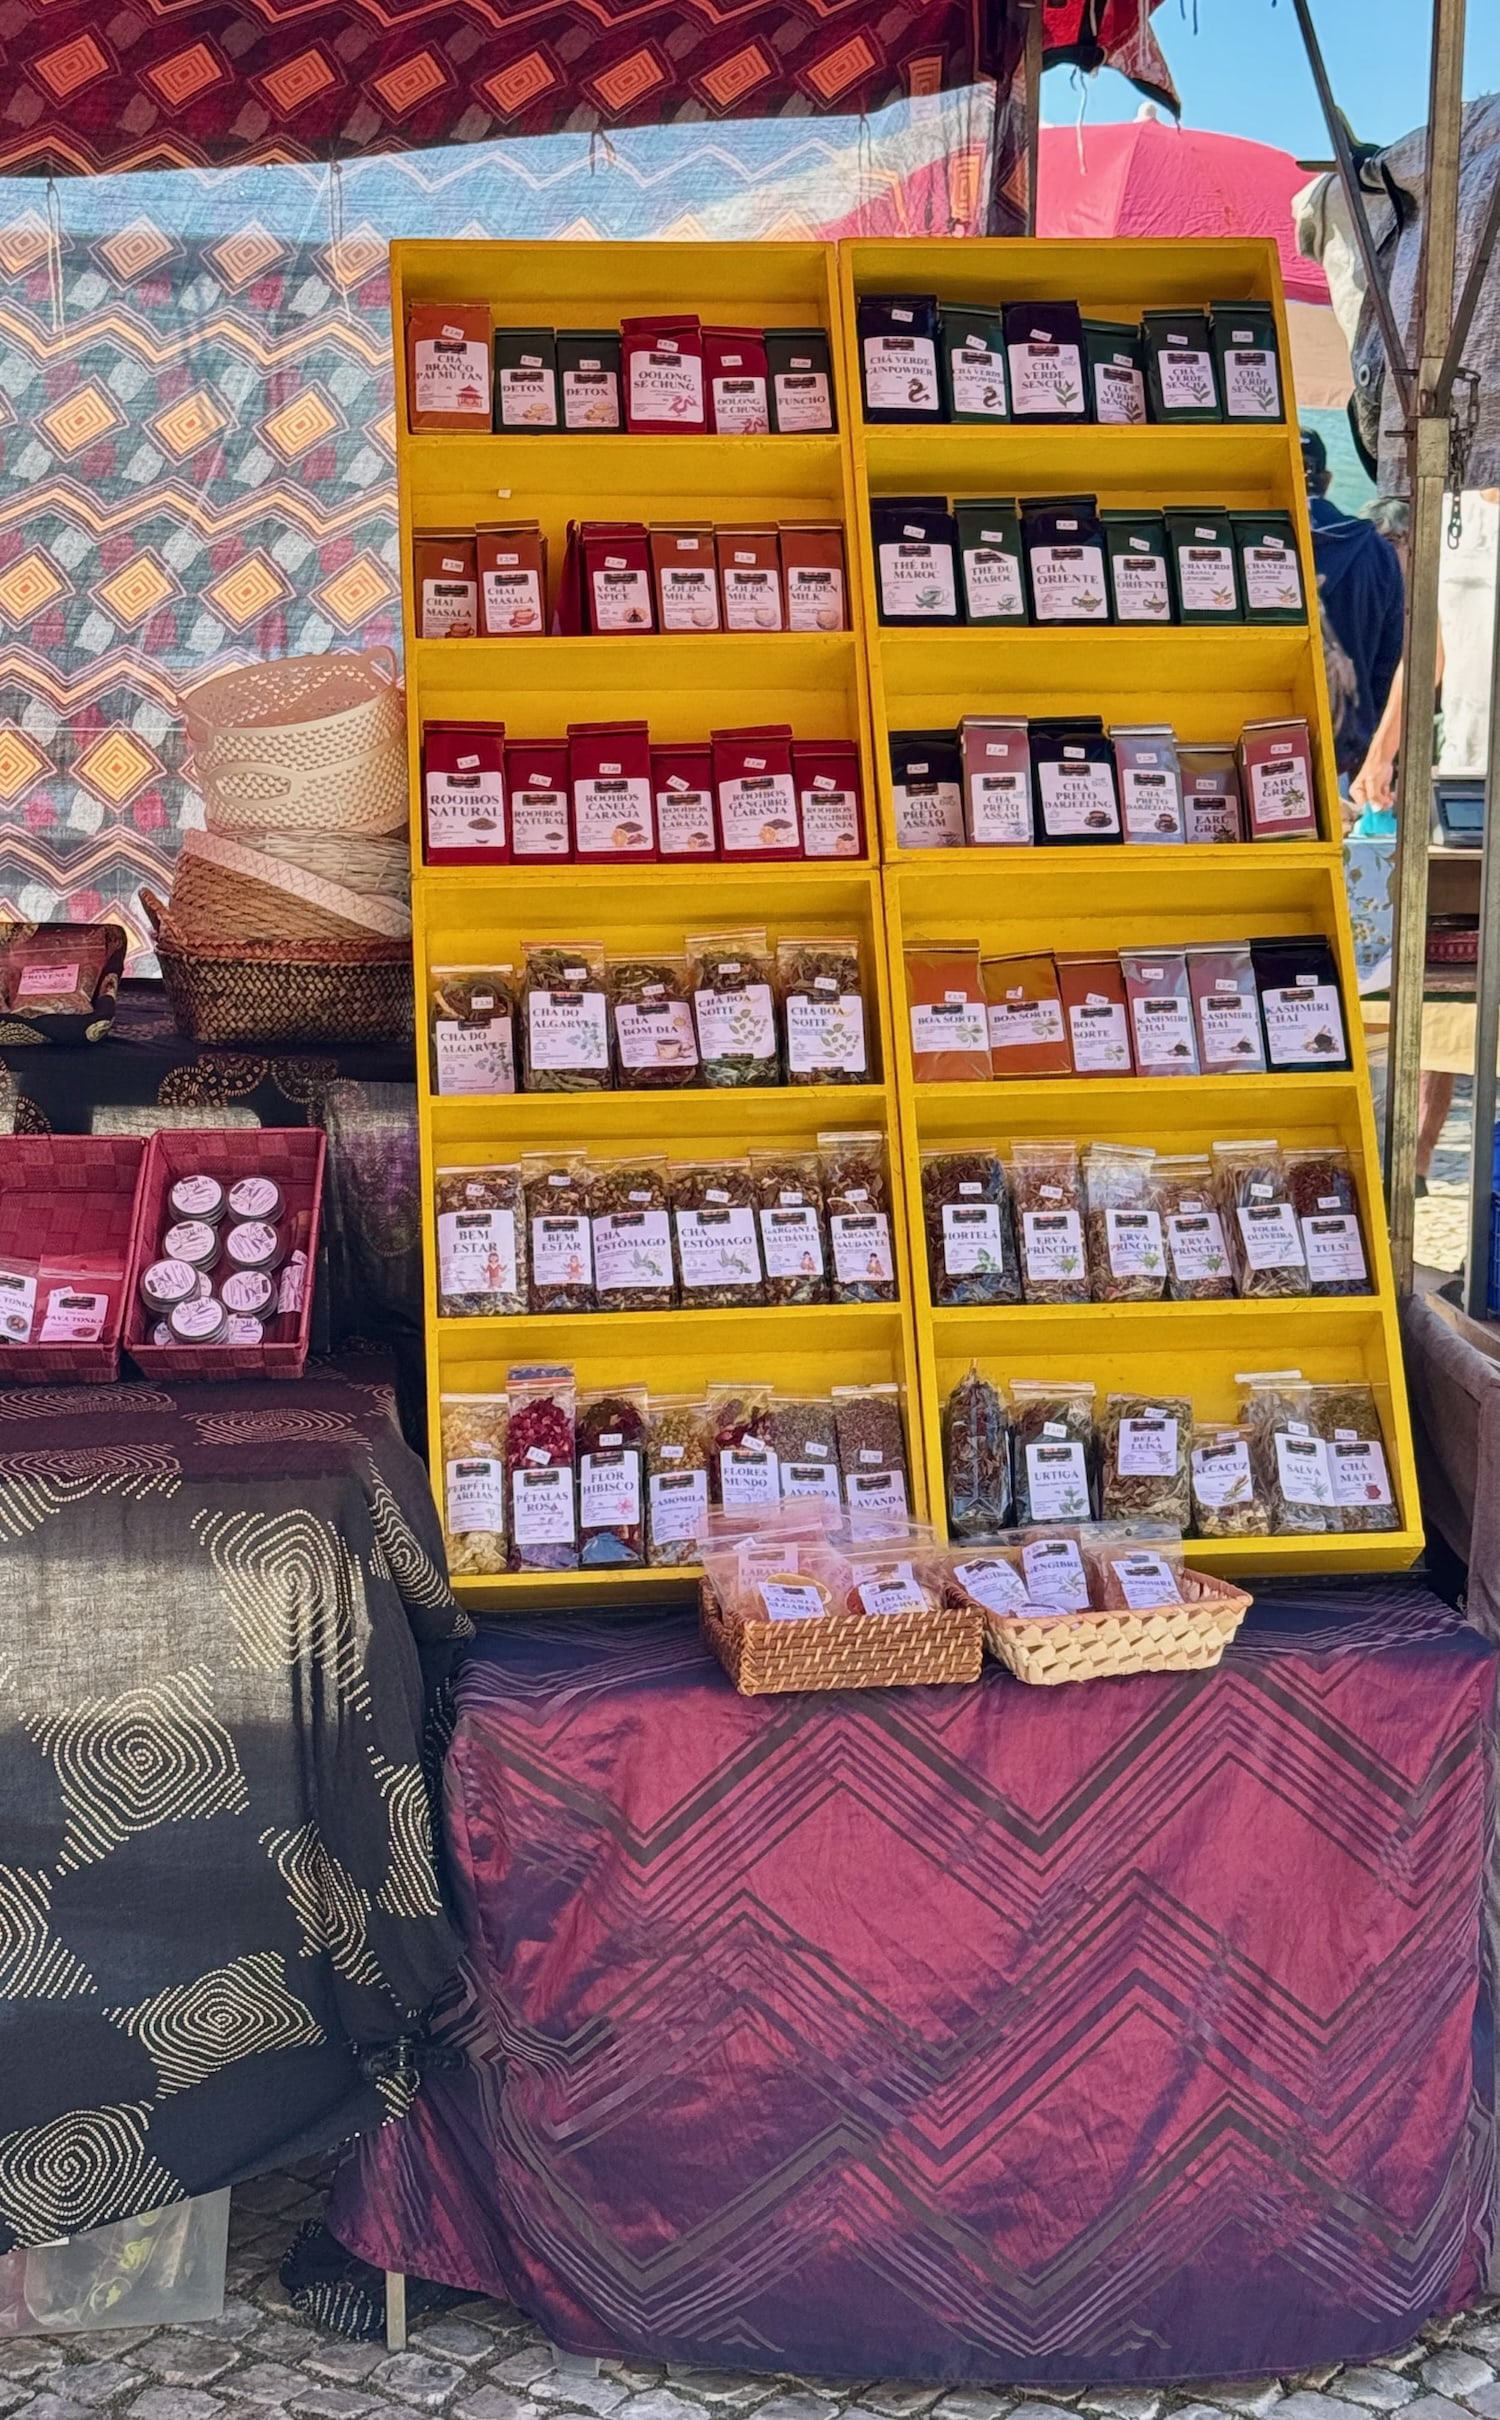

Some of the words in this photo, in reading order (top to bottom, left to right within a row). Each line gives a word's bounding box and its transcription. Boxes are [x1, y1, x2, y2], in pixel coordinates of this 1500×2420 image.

[898, 357, 930, 365] VERDE
[867, 367, 933, 376] GUNPOWDER
[639, 371, 692, 382] OOLONG
[634, 380, 649, 388] SE
[651, 380, 694, 391] CHUNG
[567, 388, 608, 396] DETOX
[778, 396, 825, 405] FUNCHO
[921, 562, 938, 570] DU
[999, 566, 1014, 574] DU
[894, 570, 939, 579] MAROC
[972, 574, 1014, 584] MAROC
[1037, 574, 1098, 585] ORIENTE
[597, 585, 627, 593] YOGI
[663, 584, 711, 593] GOLDEN
[726, 584, 774, 593] GOLDEN
[789, 584, 838, 593] GOLDEN
[1117, 581, 1168, 589] ORIENTE
[487, 587, 515, 596] CHAI
[488, 596, 534, 605] MASALA
[597, 593, 630, 601] SPICE
[665, 593, 695, 601] MILK
[728, 593, 758, 601] MILK
[791, 592, 821, 601] MILK
[426, 598, 454, 606] CHAI
[426, 609, 471, 618] MASALA
[1263, 780, 1294, 789] EARL
[430, 795, 500, 805] ROOIBOS
[585, 794, 640, 803] ROOIBOS
[733, 790, 786, 802] ROOIBOS
[1055, 792, 1097, 800] PRETO
[729, 799, 790, 810] GENGIBRE
[1044, 800, 1112, 809] DARJEELING
[1135, 797, 1168, 805] PRETO
[588, 802, 636, 811] CANELA
[983, 804, 1020, 812] PRETO
[429, 807, 501, 817] NATURAL
[514, 810, 565, 818] ROOIBOS
[585, 811, 640, 820] LARANJA
[733, 807, 788, 817] LARANJA
[903, 810, 944, 820] PRETO
[983, 812, 1020, 820] ASSAM
[905, 819, 947, 828] ASSAM
[1196, 815, 1229, 824] EARL
[662, 820, 709, 829] LARANJA
[807, 821, 854, 829] LARANJA
[727, 994, 752, 1003] BOA
[562, 1008, 580, 1016] DO
[700, 1006, 736, 1017] NOITE
[1265, 1002, 1329, 1014] KASHMIRI
[918, 1016, 942, 1025] BOA
[944, 1015, 979, 1024] SORTE
[994, 1014, 1017, 1023] BOA
[1019, 1010, 1055, 1019] SORTE
[1137, 1016, 1188, 1024] KASHMIRI
[1266, 1014, 1299, 1024] CHAI
[533, 1020, 599, 1028] ALGARVE
[792, 1019, 828, 1027] NOITE
[1073, 1020, 1096, 1029] BOA
[624, 1027, 652, 1035] BOM
[656, 1025, 678, 1033] DIA
[1074, 1030, 1110, 1039] SORTE
[470, 1032, 486, 1040] DO
[441, 1042, 507, 1054] ALGARVE
[764, 1226, 818, 1234] GARGANTA
[459, 1230, 489, 1240] BEM
[547, 1233, 575, 1242] BEM
[834, 1231, 888, 1240] GARGANTA
[1119, 1234, 1149, 1242] ERVA
[1247, 1232, 1294, 1241] OLIVEIRA
[683, 1236, 753, 1248] ESTÔMAGO
[1036, 1236, 1068, 1244] ERVA
[1181, 1237, 1212, 1245] ERVA
[453, 1242, 497, 1253] ESTAR
[542, 1242, 581, 1251] ESTAR
[597, 1239, 665, 1253] ESTÔMAGO
[1314, 1243, 1350, 1253] TULSI
[1133, 1435, 1160, 1443] BELA
[724, 1468, 768, 1477] FLORES
[1286, 1464, 1321, 1476] SALVA
[591, 1472, 625, 1482] FLOR
[1035, 1471, 1079, 1481] URTIGA
[1340, 1473, 1376, 1482] MATE
[724, 1478, 768, 1487] MUNDO
[583, 1482, 634, 1494] HIBISCO
